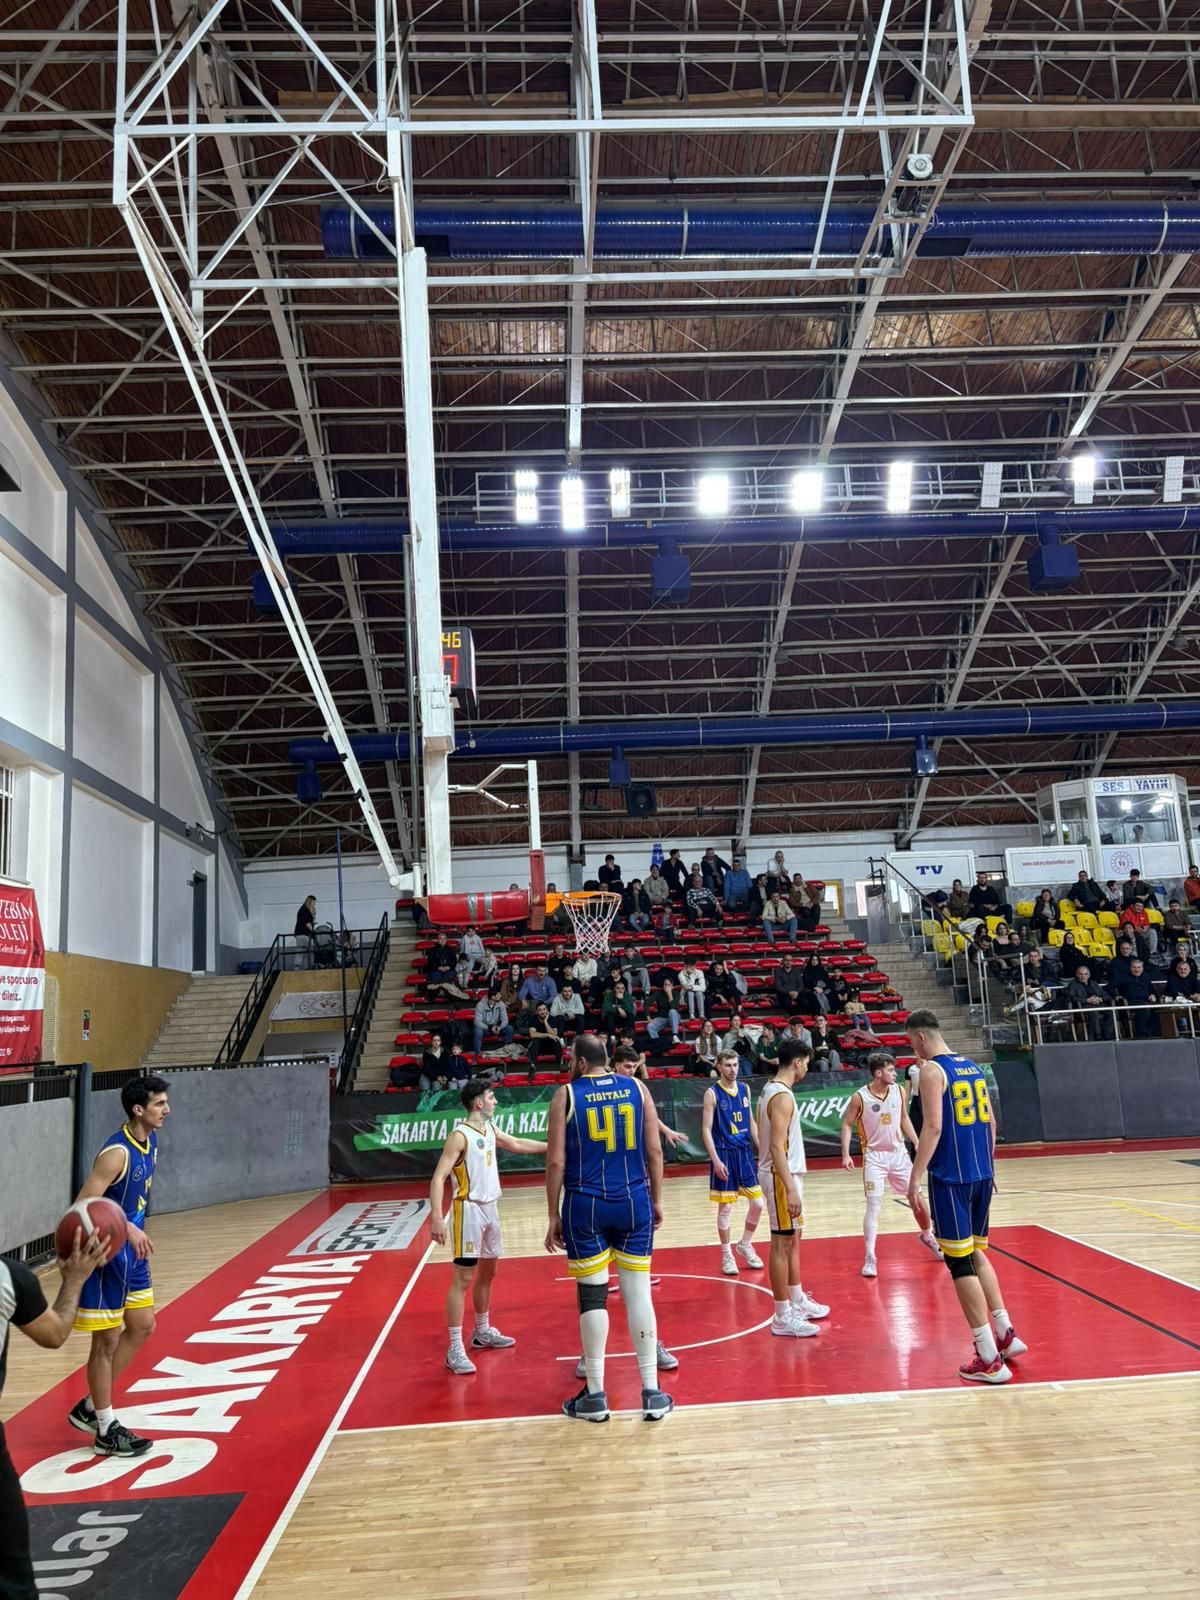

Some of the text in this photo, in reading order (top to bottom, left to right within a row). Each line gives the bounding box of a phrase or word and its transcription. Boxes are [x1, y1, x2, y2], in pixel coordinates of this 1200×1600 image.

[1102, 782, 1124, 792] SES
[916, 865, 943, 875] TV
[732, 1111, 743, 1122] 10
[952, 1078, 991, 1126] 28
[381, 1119, 448, 1145] SAKARYA
[518, 1110, 548, 1134] KAZ
[586, 1102, 637, 1153] 41
[20, 1254, 371, 1494] SAKARYA
